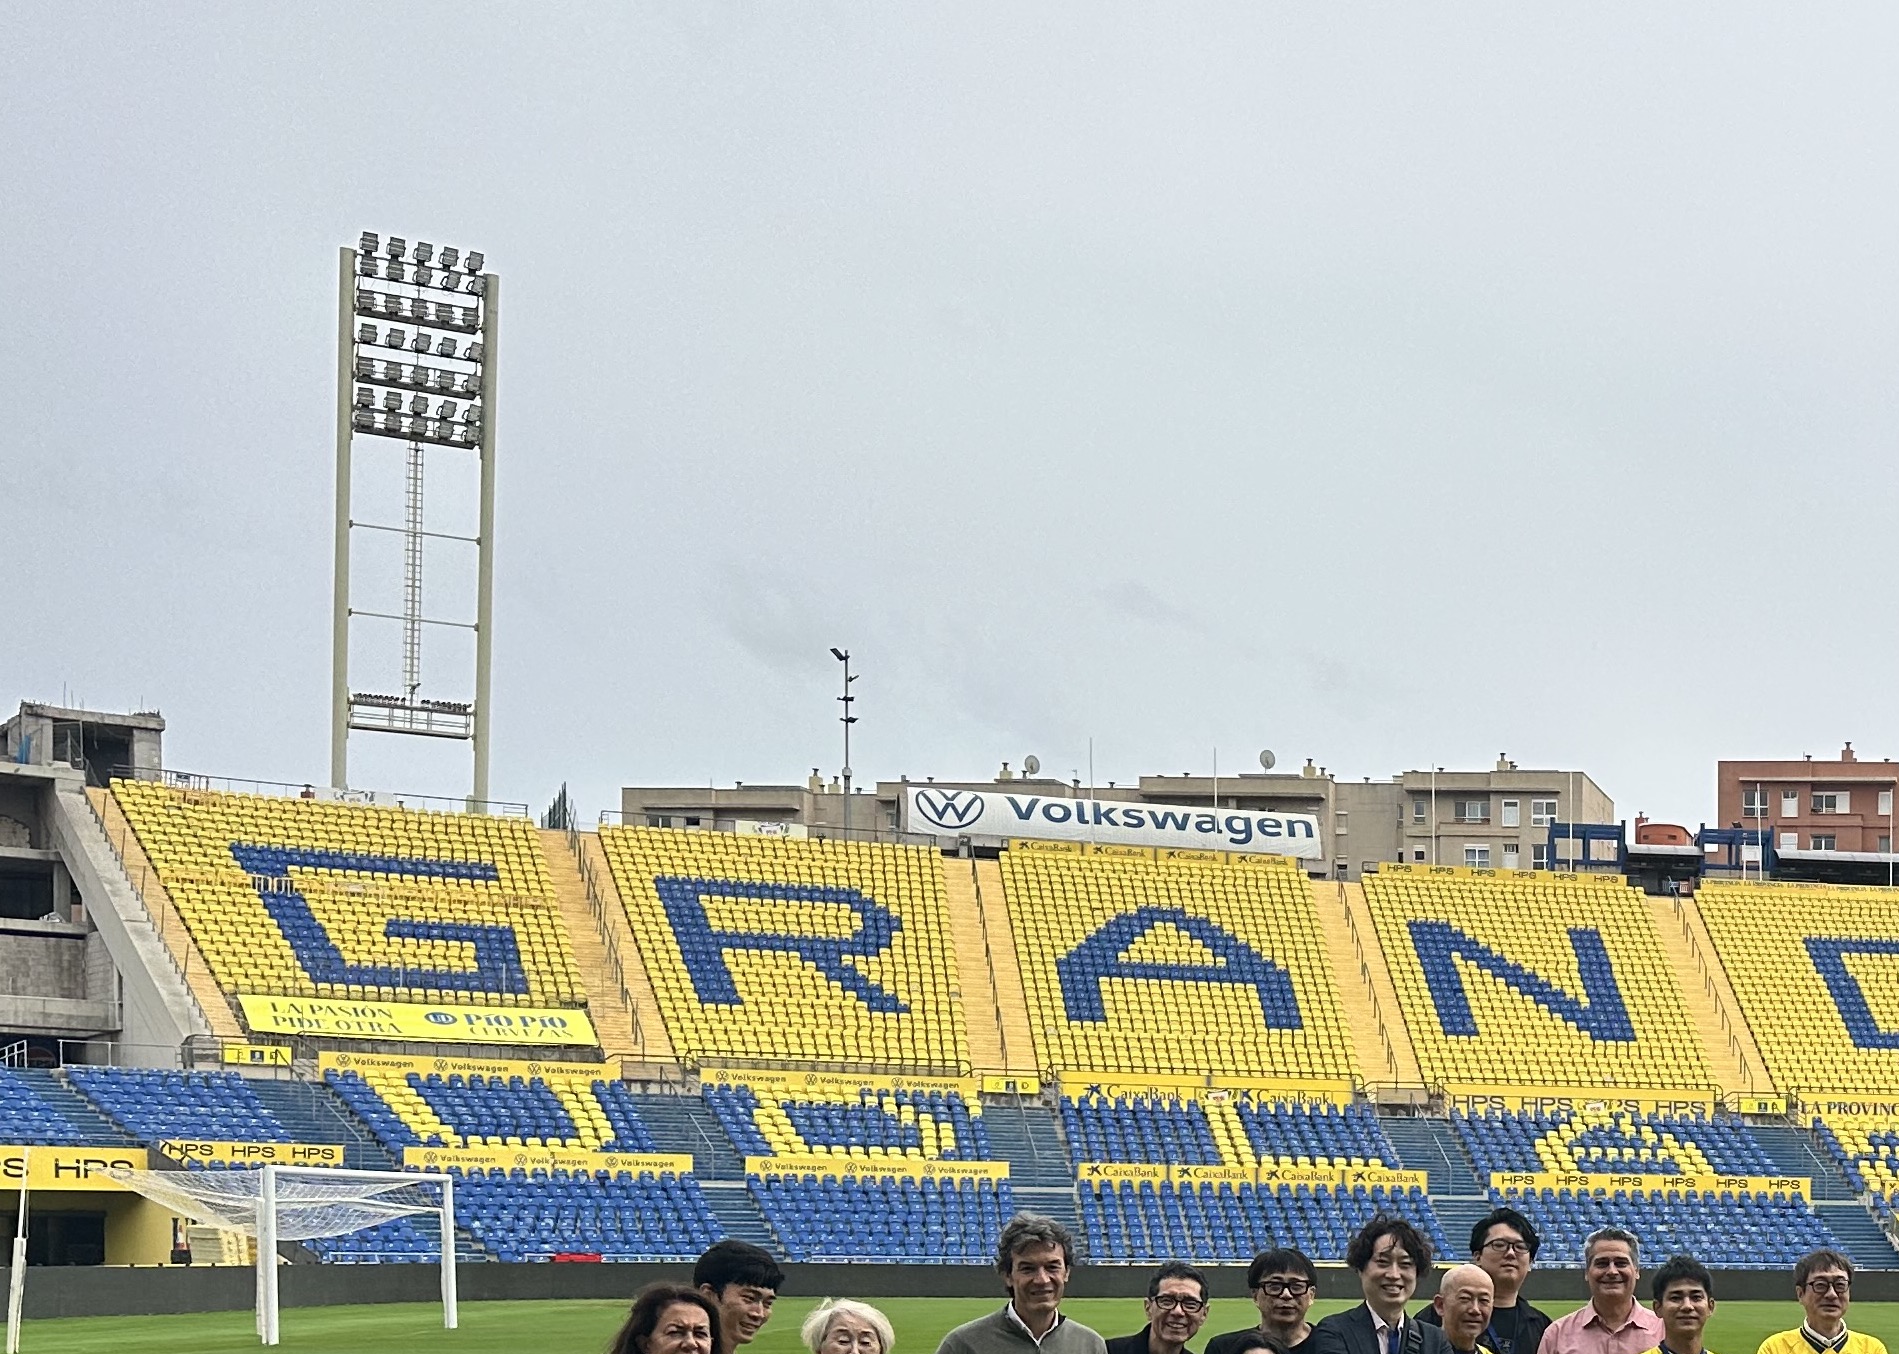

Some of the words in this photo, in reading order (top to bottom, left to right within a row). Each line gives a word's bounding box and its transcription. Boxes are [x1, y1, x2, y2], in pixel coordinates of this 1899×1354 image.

[1004, 795, 1315, 845] Volkswagen
[270, 1002, 302, 1014] LA
[1107, 1085, 1183, 1102] CaixaBank
[1257, 1089, 1329, 1106] CaixaBank
[1453, 1095, 1505, 1111] HPS
[1521, 1096, 1573, 1112] HPS
[1655, 1101, 1706, 1115] HPS
[168, 1143, 214, 1156] HPS
[232, 1145, 275, 1158] HPS
[292, 1147, 335, 1160] HPS
[1102, 1165, 1159, 1178] CaixaBank
[1194, 1167, 1248, 1180] CaixaBank
[1282, 1169, 1335, 1182] CaixaBank
[1367, 1171, 1419, 1184] CaixaBank
[1502, 1175, 1534, 1185] HPS
[1556, 1176, 1589, 1186] HPS
[1610, 1177, 1643, 1187] HPS
[1663, 1178, 1696, 1188] HPS
[1716, 1179, 1748, 1189] HPS
[1769, 1180, 1800, 1190] HPS
